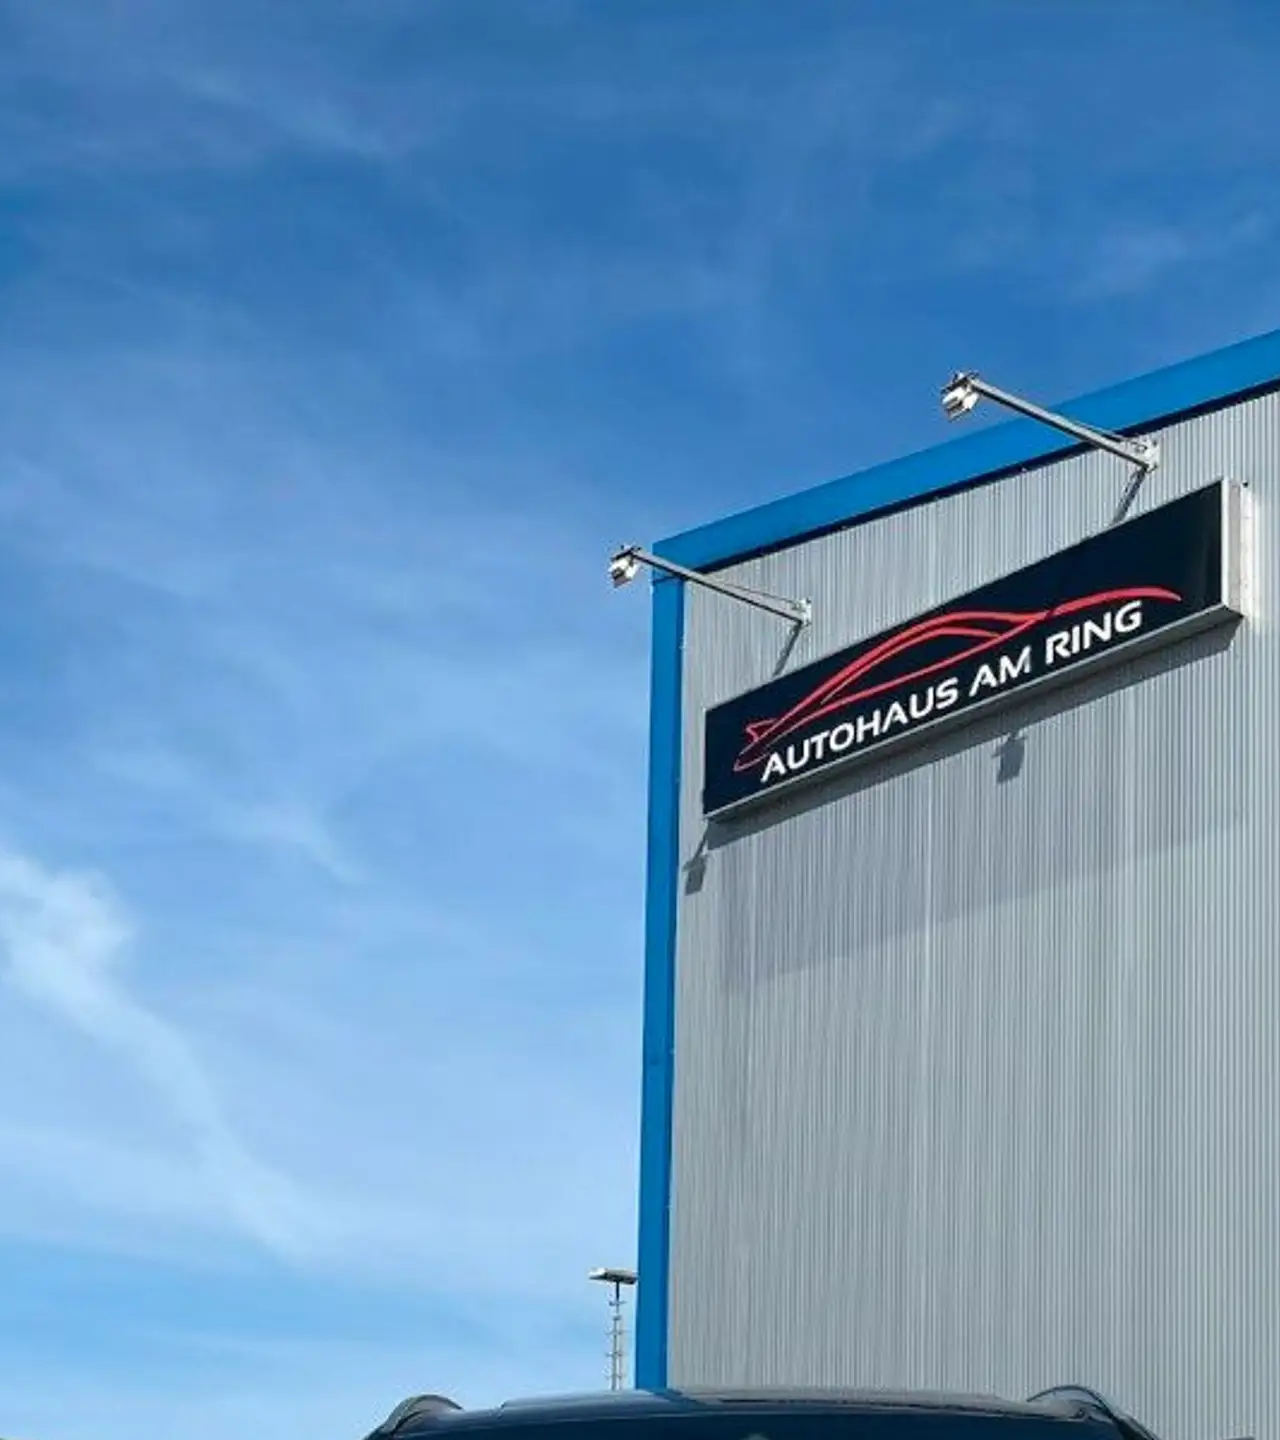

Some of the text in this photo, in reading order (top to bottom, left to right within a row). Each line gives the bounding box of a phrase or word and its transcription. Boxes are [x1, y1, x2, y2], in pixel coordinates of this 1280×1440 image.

[760, 600, 1142, 783] AUTOHAUS AM RING
